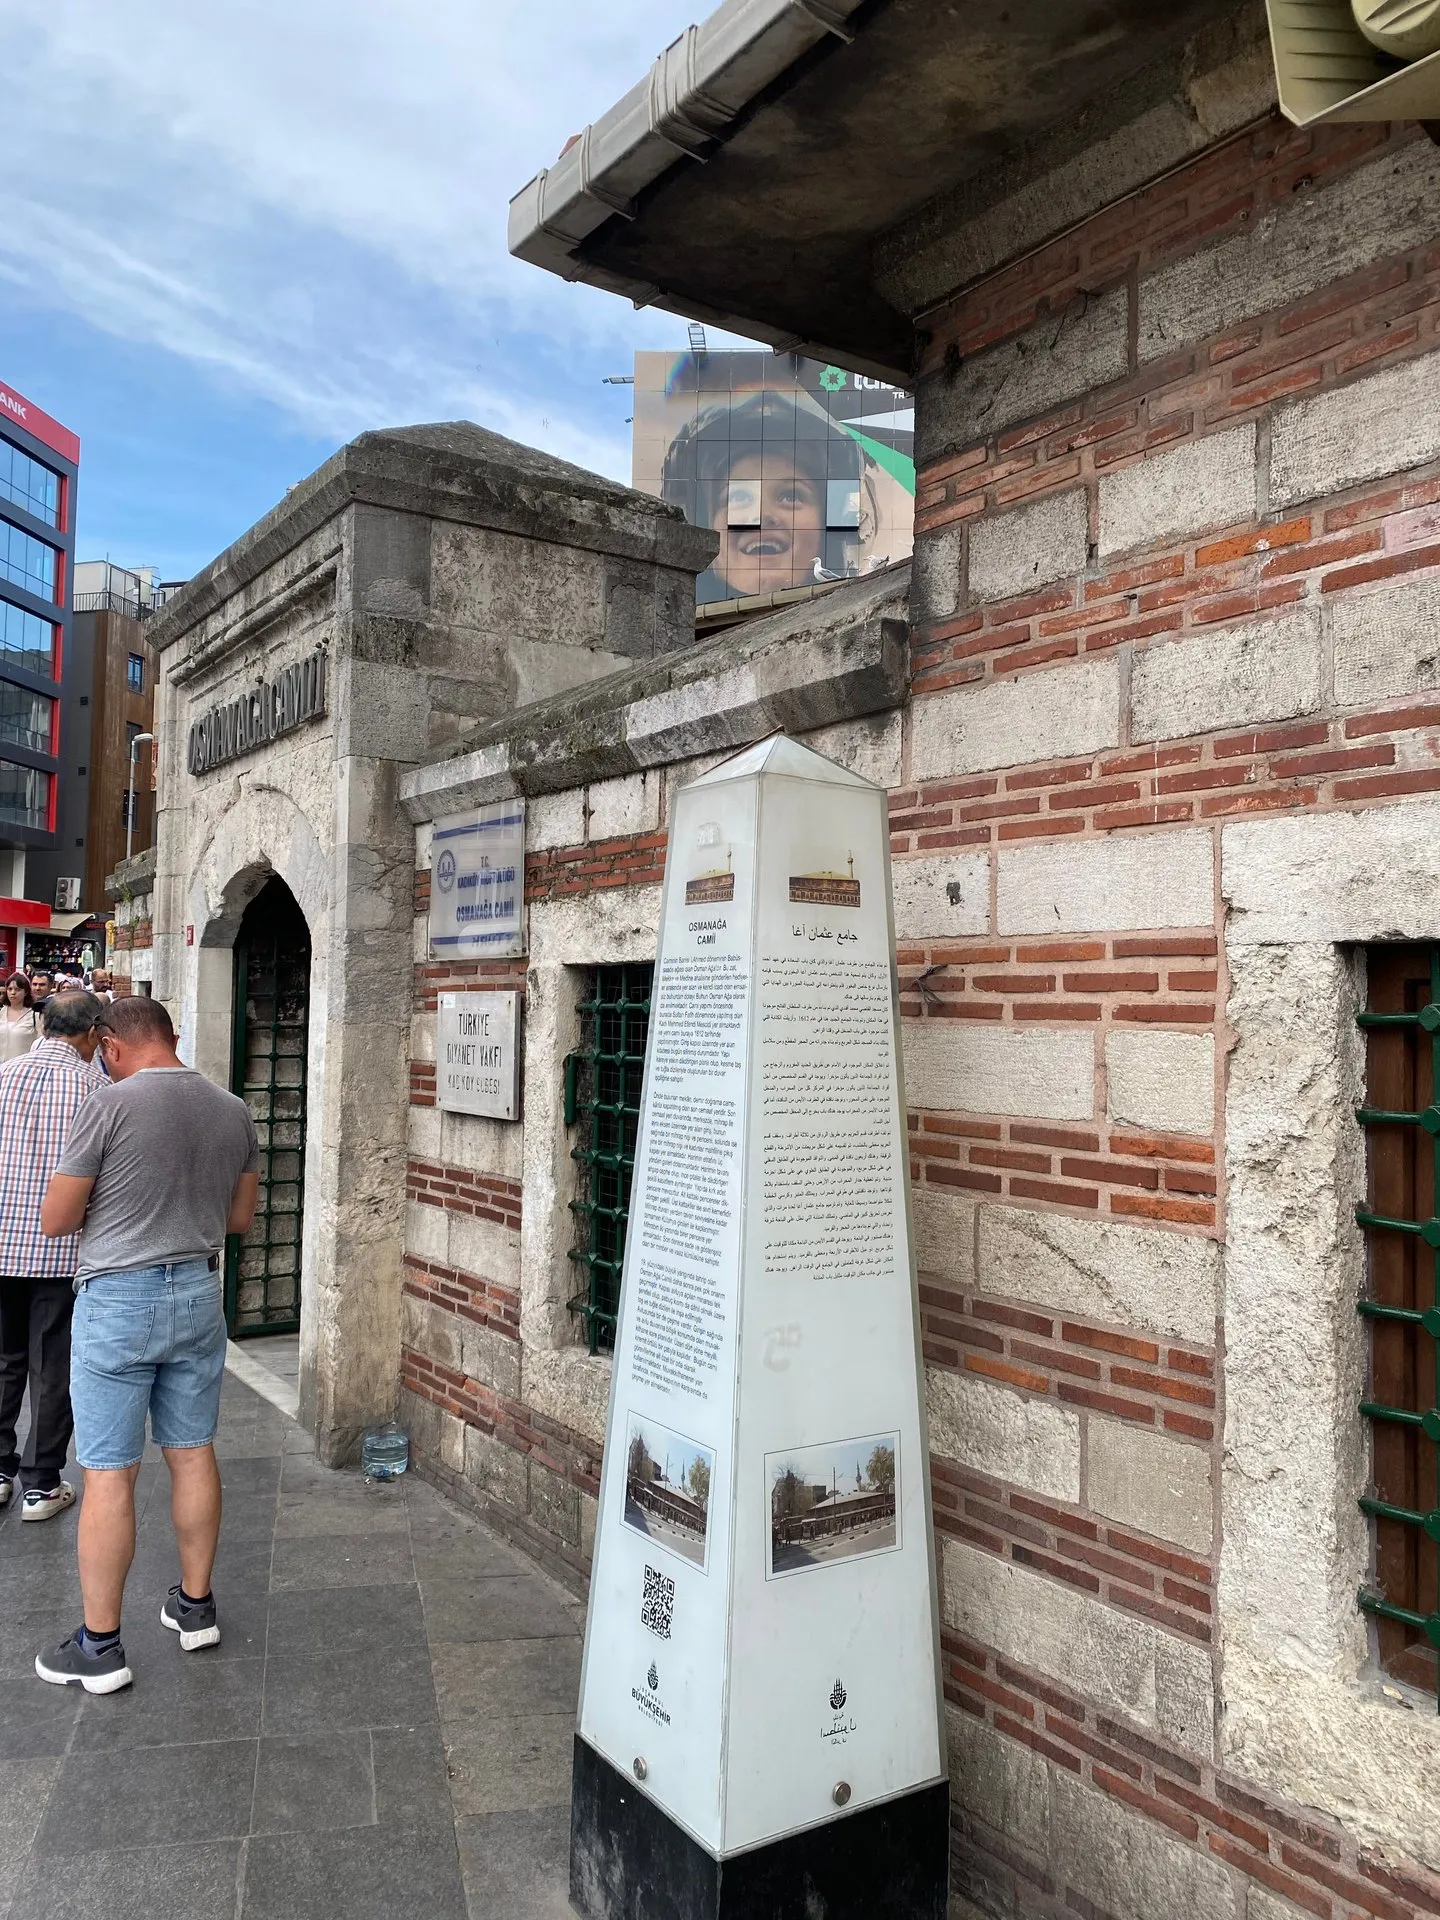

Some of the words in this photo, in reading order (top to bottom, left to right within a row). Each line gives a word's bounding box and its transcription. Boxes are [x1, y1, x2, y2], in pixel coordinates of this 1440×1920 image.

[456, 898, 493, 922] OSMANAĞA
[494, 896, 514, 918] CAMİİ
[688, 918, 727, 932] OSMANAĞA
[791, 923, 806, 937] آغا
[808, 926, 834, 941] عثمان
[836, 929, 858, 945] جامع
[458, 1008, 490, 1036] TÜRKİYE
[480, 1045, 502, 1068] VAKFI
